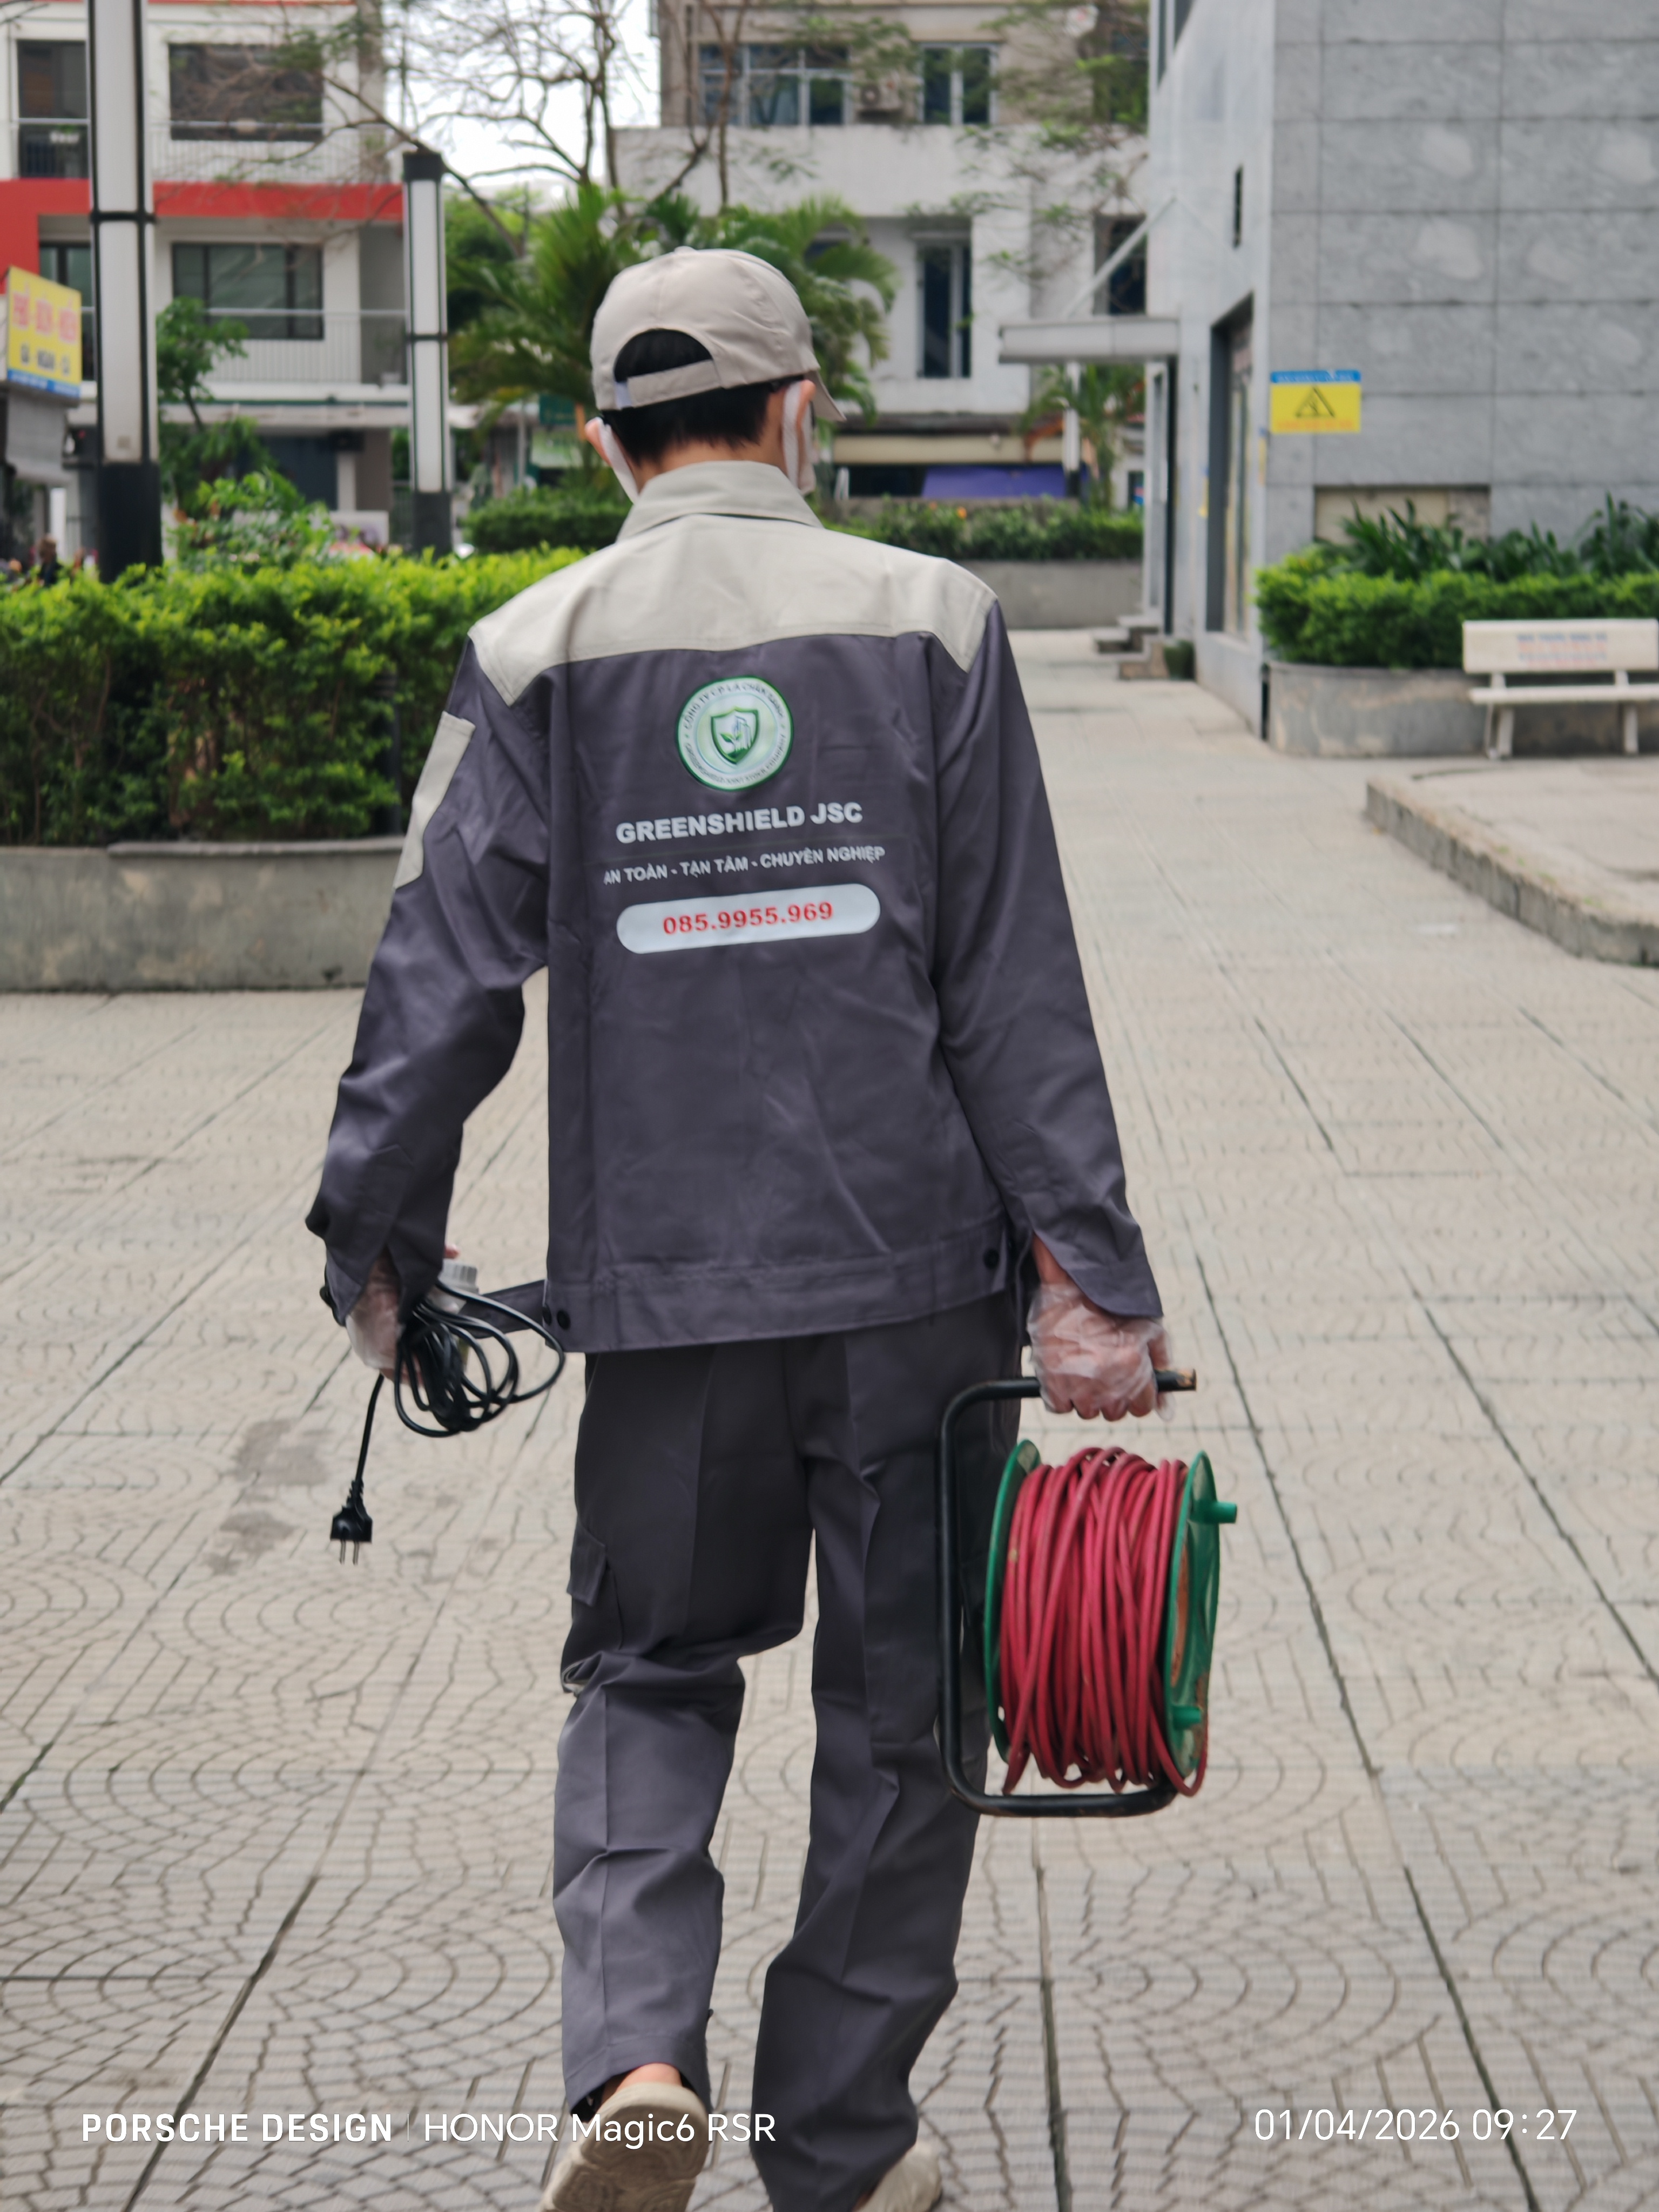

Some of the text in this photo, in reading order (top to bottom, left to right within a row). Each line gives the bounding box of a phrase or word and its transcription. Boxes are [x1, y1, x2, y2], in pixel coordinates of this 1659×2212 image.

[616, 802, 863, 844] GREENSHIELD JSC
[603, 869, 621, 885] AN
[623, 862, 668, 882] TOÀN
[713, 855, 748, 874] TÂM
[663, 902, 833, 935] 085.9955.969
